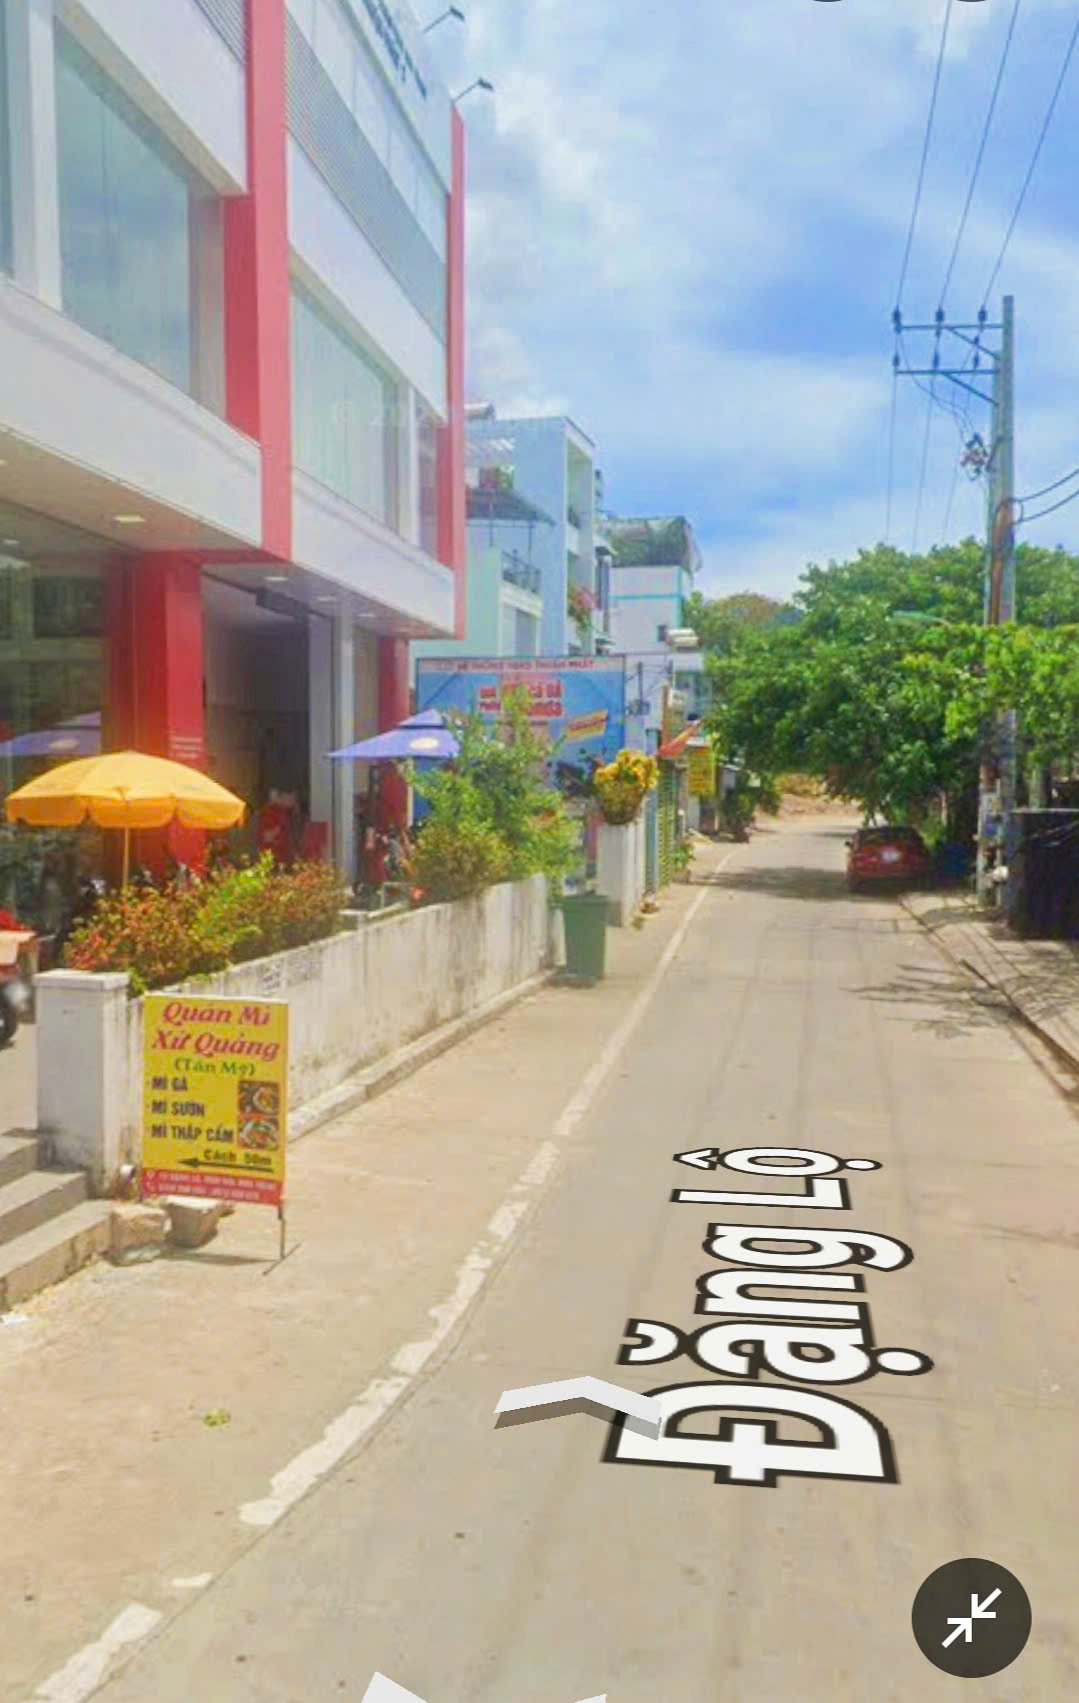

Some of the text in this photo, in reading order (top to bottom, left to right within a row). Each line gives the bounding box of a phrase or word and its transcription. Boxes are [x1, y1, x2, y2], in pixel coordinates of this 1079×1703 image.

[163, 1001, 233, 1026] Quán
[151, 1028, 280, 1061] Xứ Quảng
